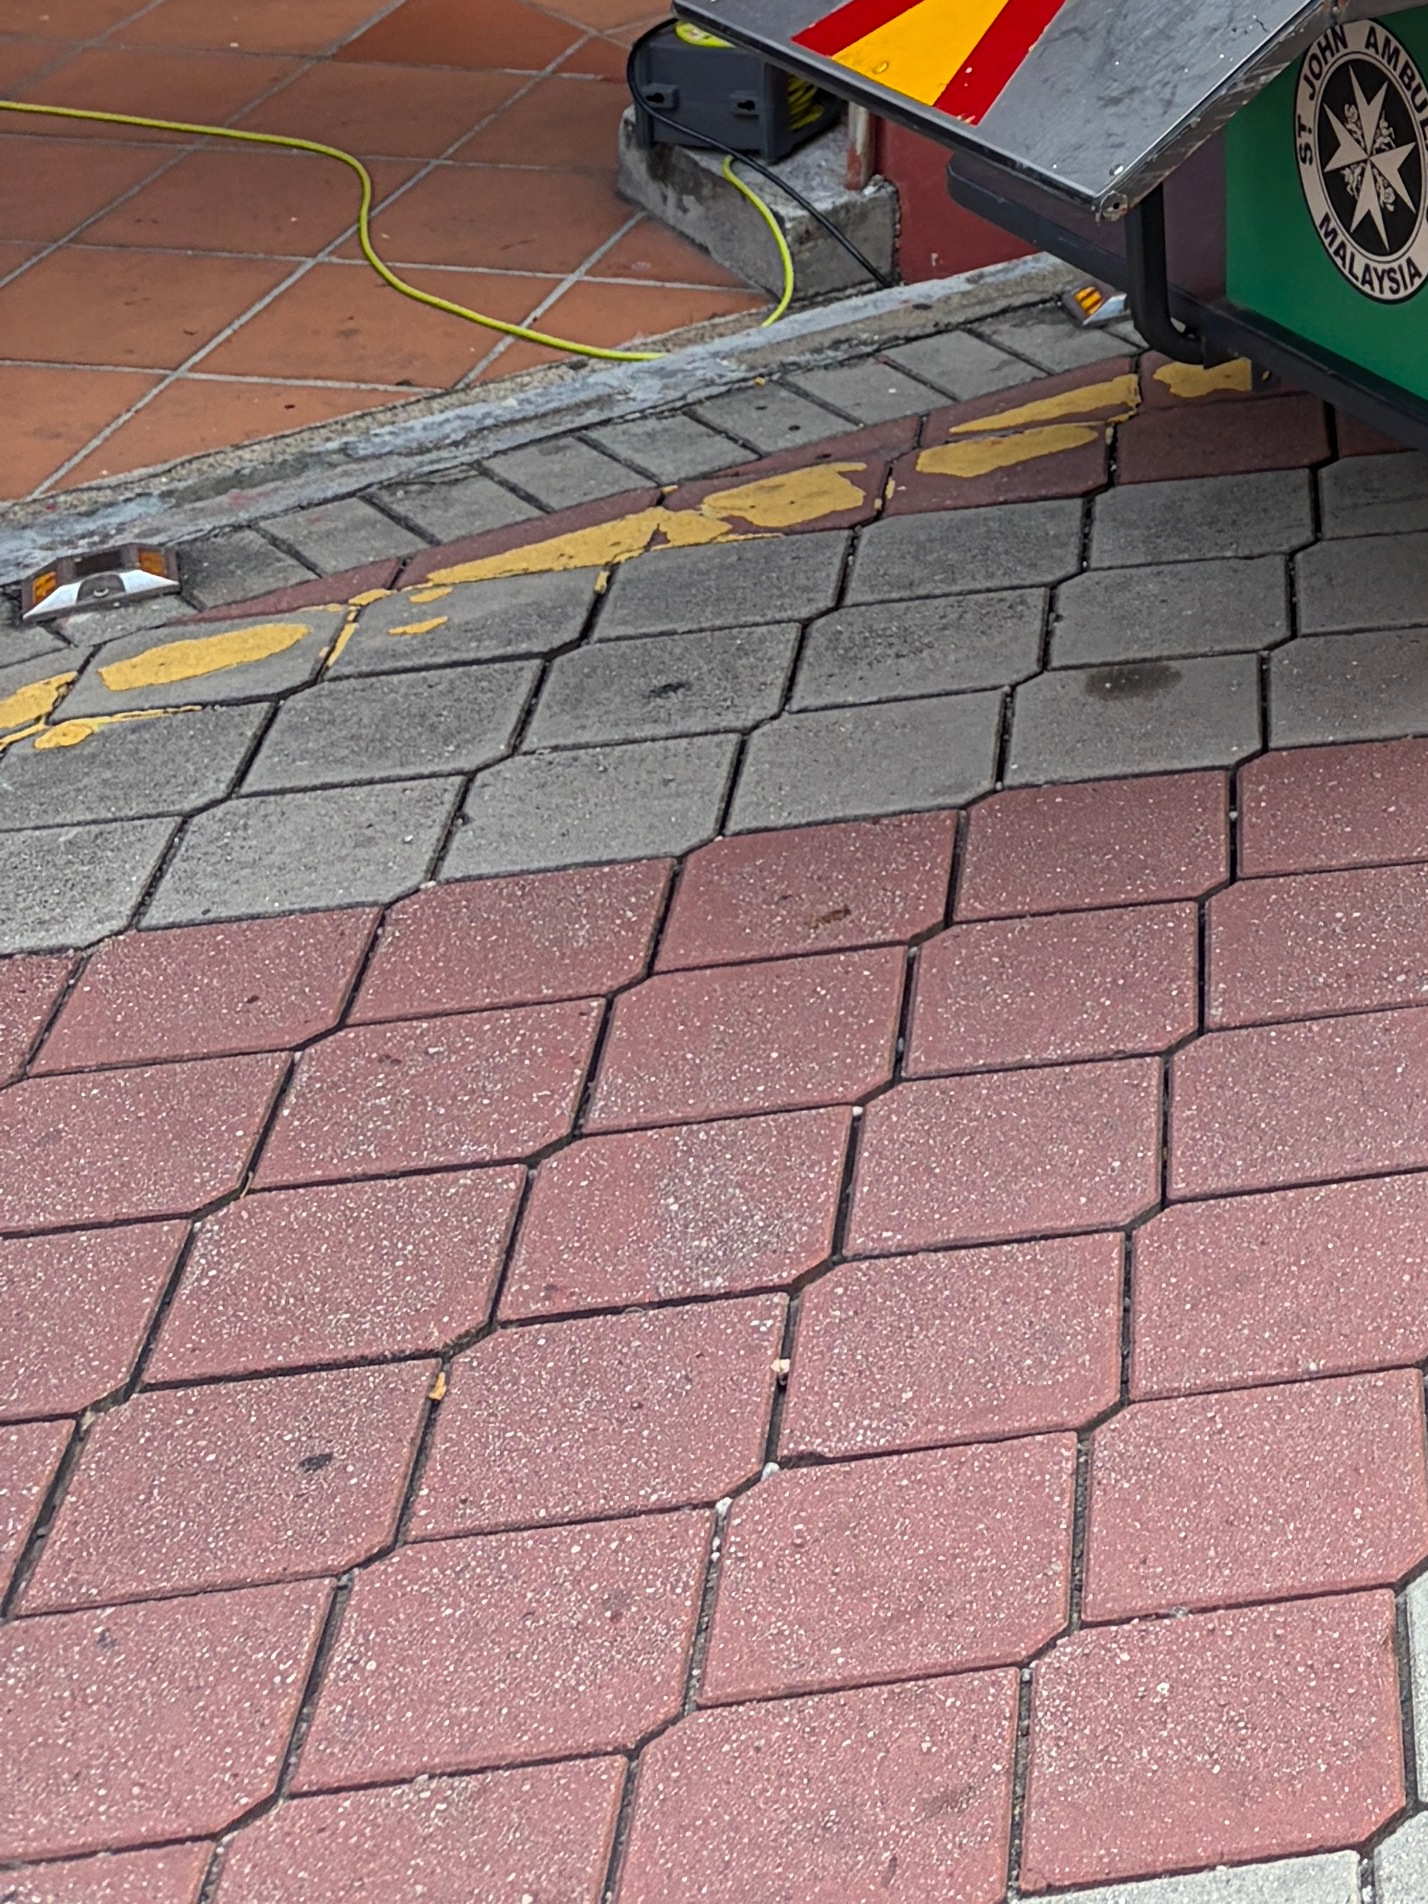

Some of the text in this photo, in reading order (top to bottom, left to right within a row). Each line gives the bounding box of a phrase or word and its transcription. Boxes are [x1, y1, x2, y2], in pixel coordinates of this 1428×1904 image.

[1302, 23, 1350, 102] JOHN
[1297, 113, 1314, 167] ST
[1319, 211, 1423, 295] MALAYSIA
